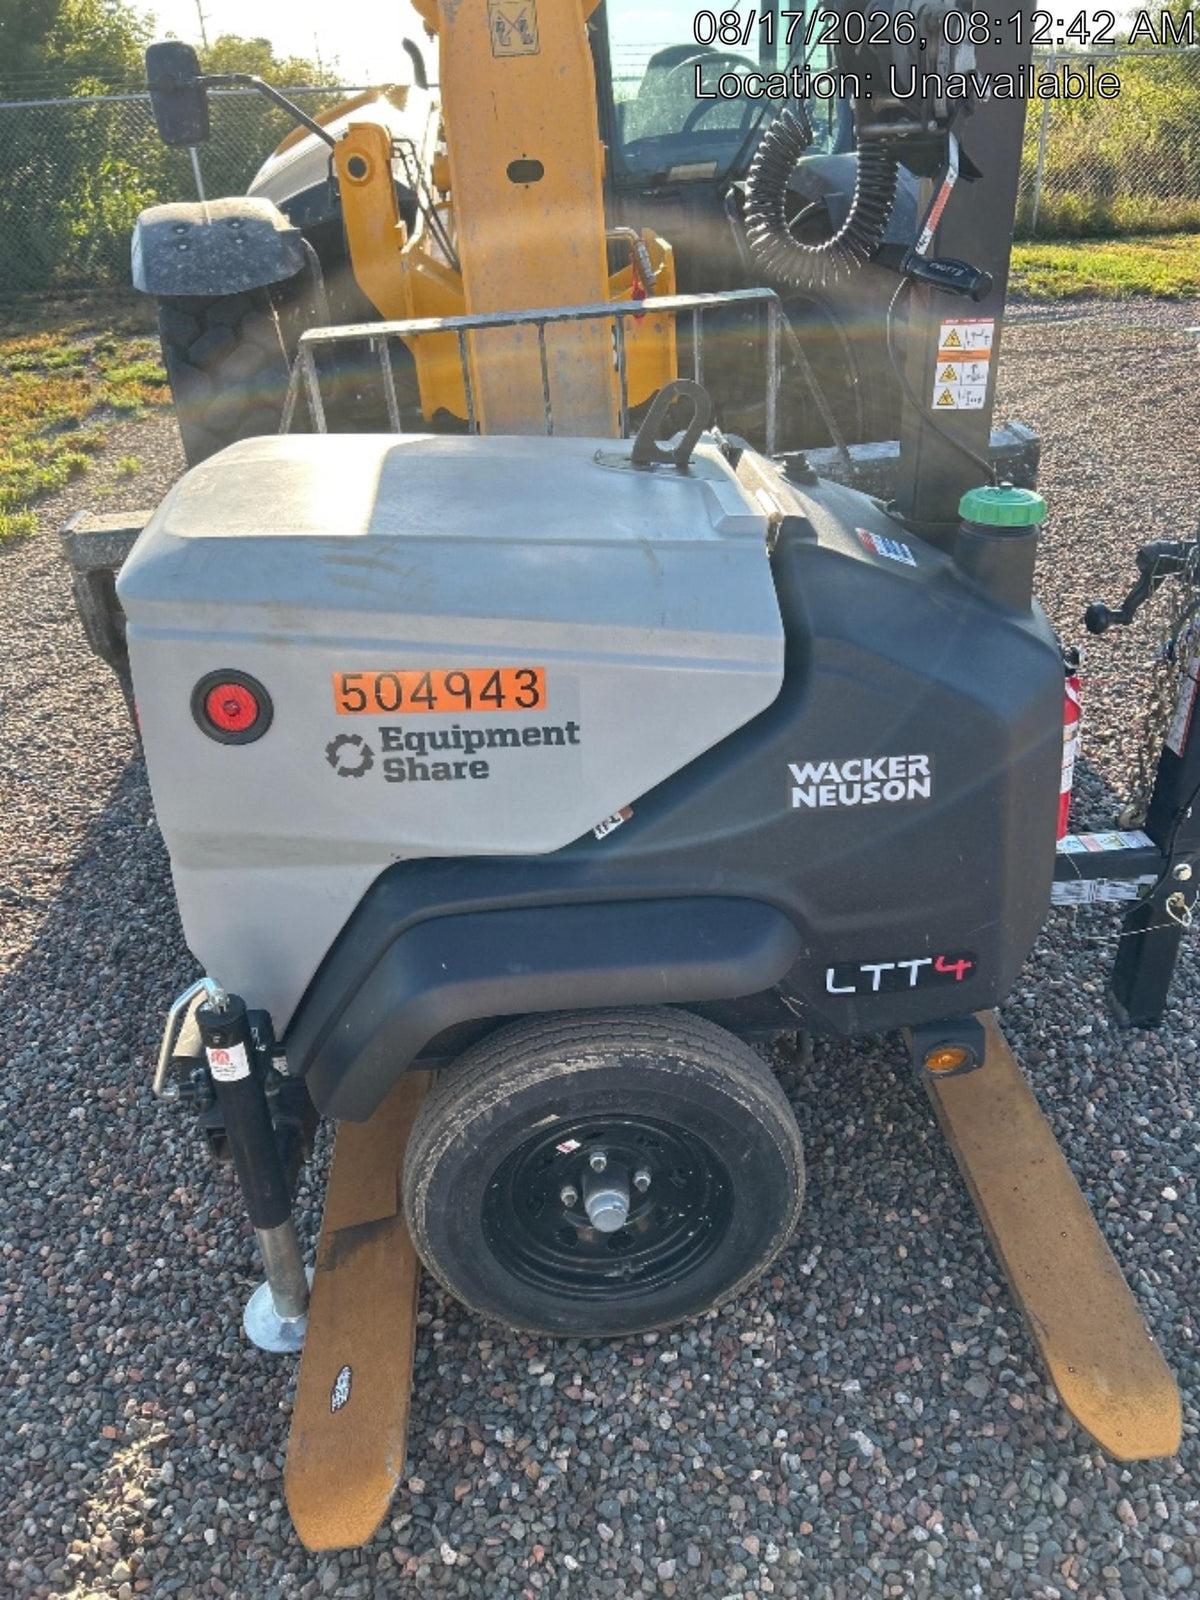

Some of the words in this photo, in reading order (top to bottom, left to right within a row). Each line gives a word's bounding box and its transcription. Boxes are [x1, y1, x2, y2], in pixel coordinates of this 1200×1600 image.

[341, 669, 539, 712] 504943
[378, 721, 580, 756] Equipment
[382, 757, 490, 783] Share
[787, 754, 931, 785] WACKER
[792, 776, 931, 808] NEUSON
[826, 955, 972, 993] LTT4
